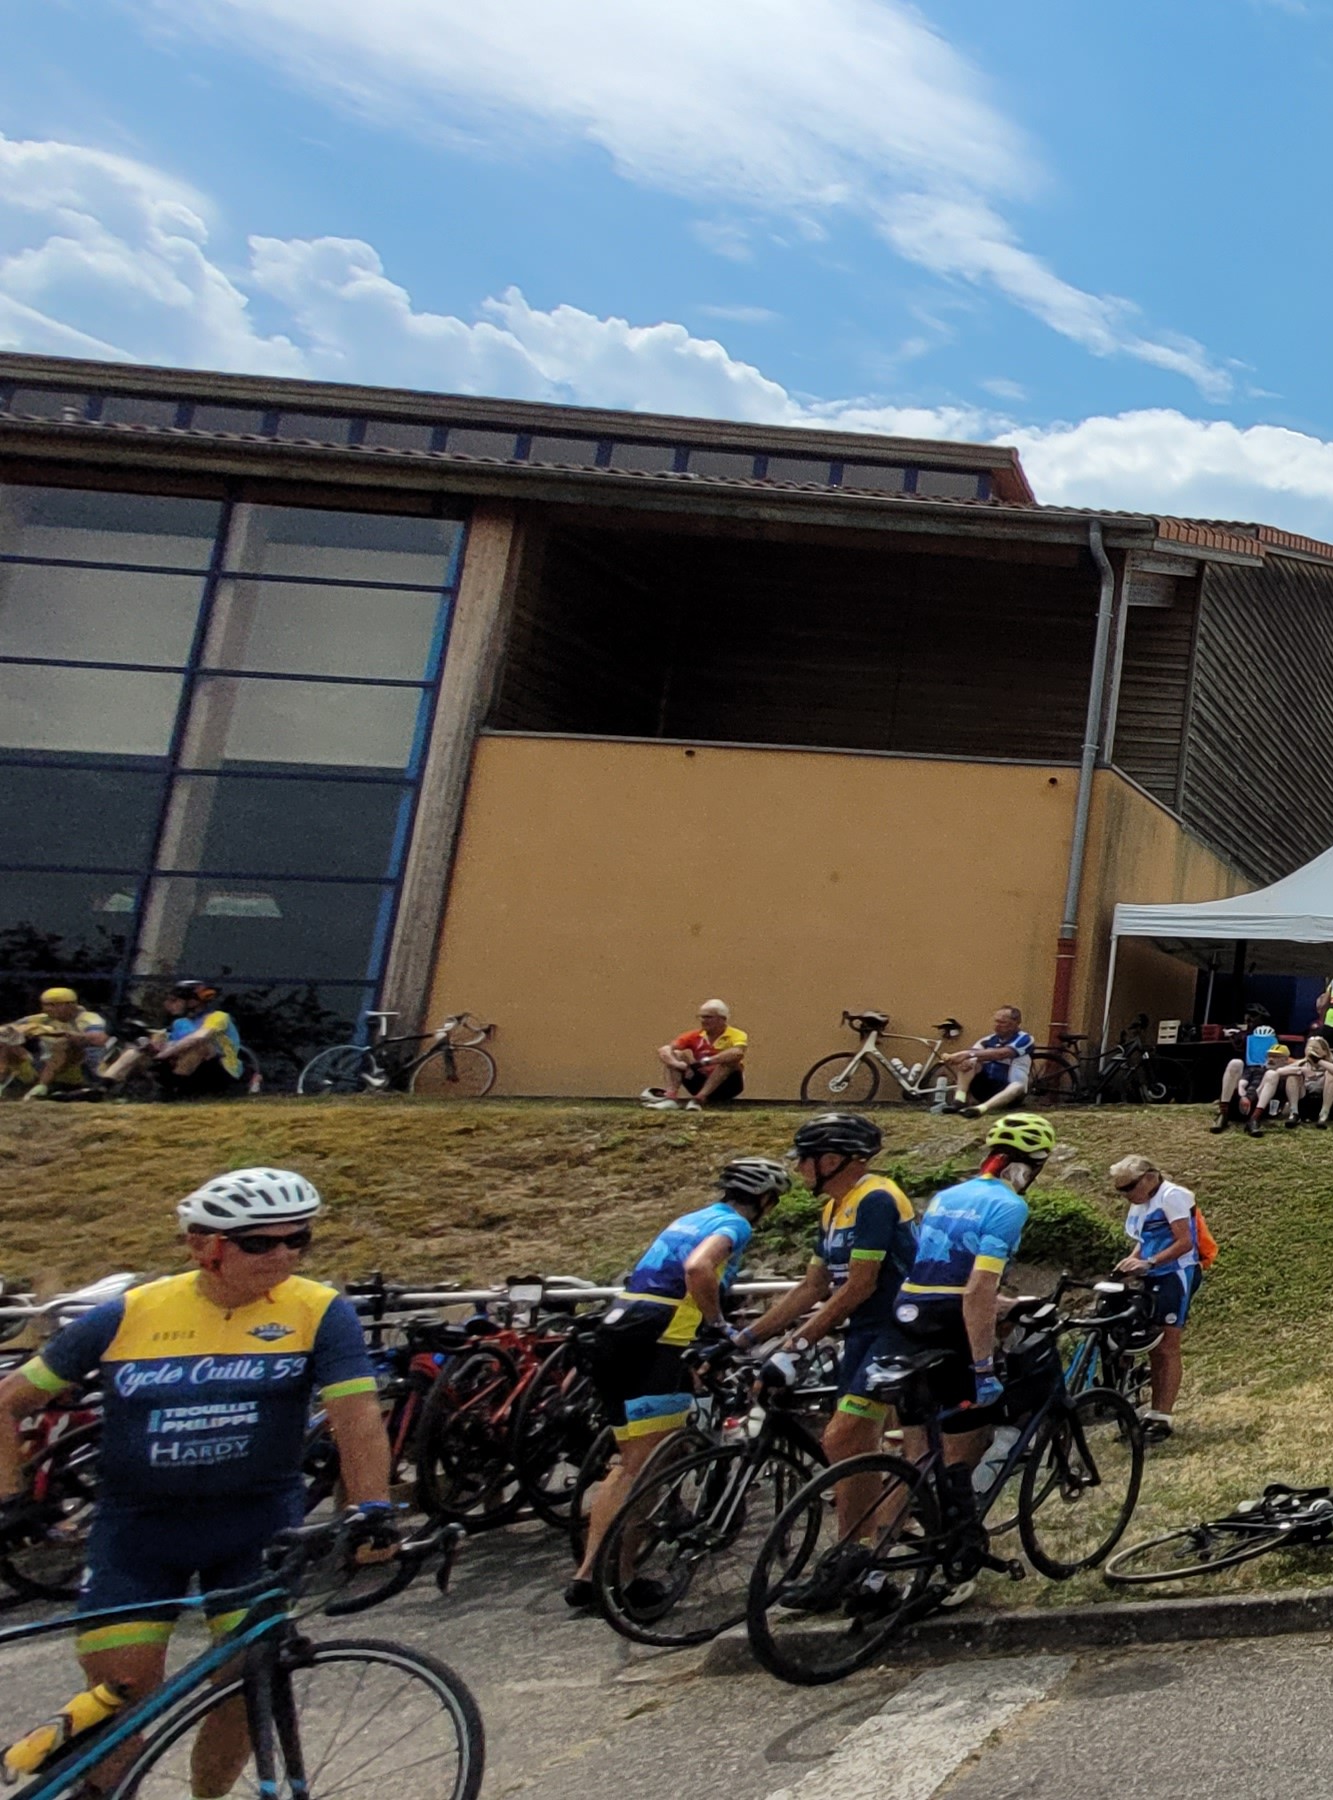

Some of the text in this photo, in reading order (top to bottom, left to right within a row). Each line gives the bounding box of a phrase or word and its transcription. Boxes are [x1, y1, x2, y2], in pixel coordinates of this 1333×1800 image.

[162, 1401, 259, 1419] TROUILLET
[161, 1412, 259, 1433] PHILIPPE
[151, 1440, 250, 1461] HARDY
